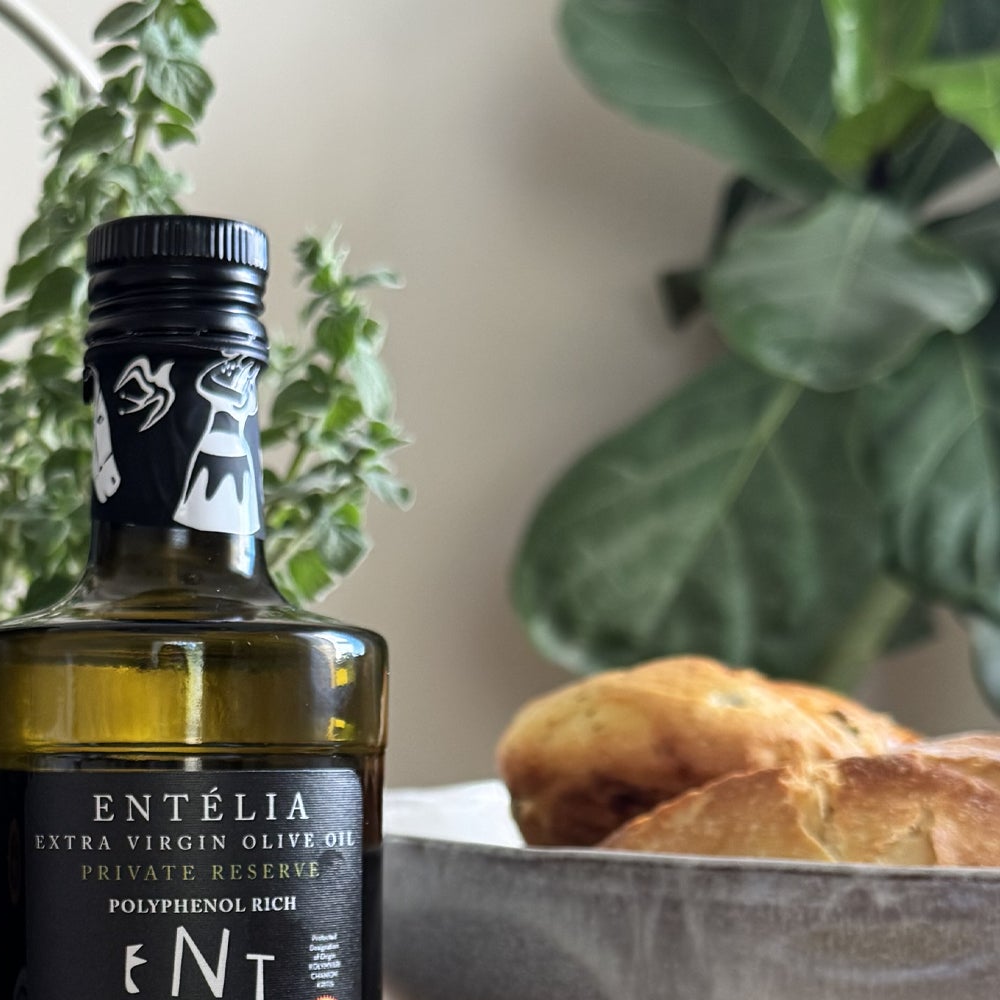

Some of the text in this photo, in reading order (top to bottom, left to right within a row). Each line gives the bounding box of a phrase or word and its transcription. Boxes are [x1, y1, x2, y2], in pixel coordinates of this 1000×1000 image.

[93, 787, 309, 822] ENTÉLIA
[35, 830, 355, 850] EXTRA VIRGIN OLIVE OIL
[81, 861, 319, 881] PRIVATE RESERVE
[109, 896, 297, 914] POLYPHENOL RICH
